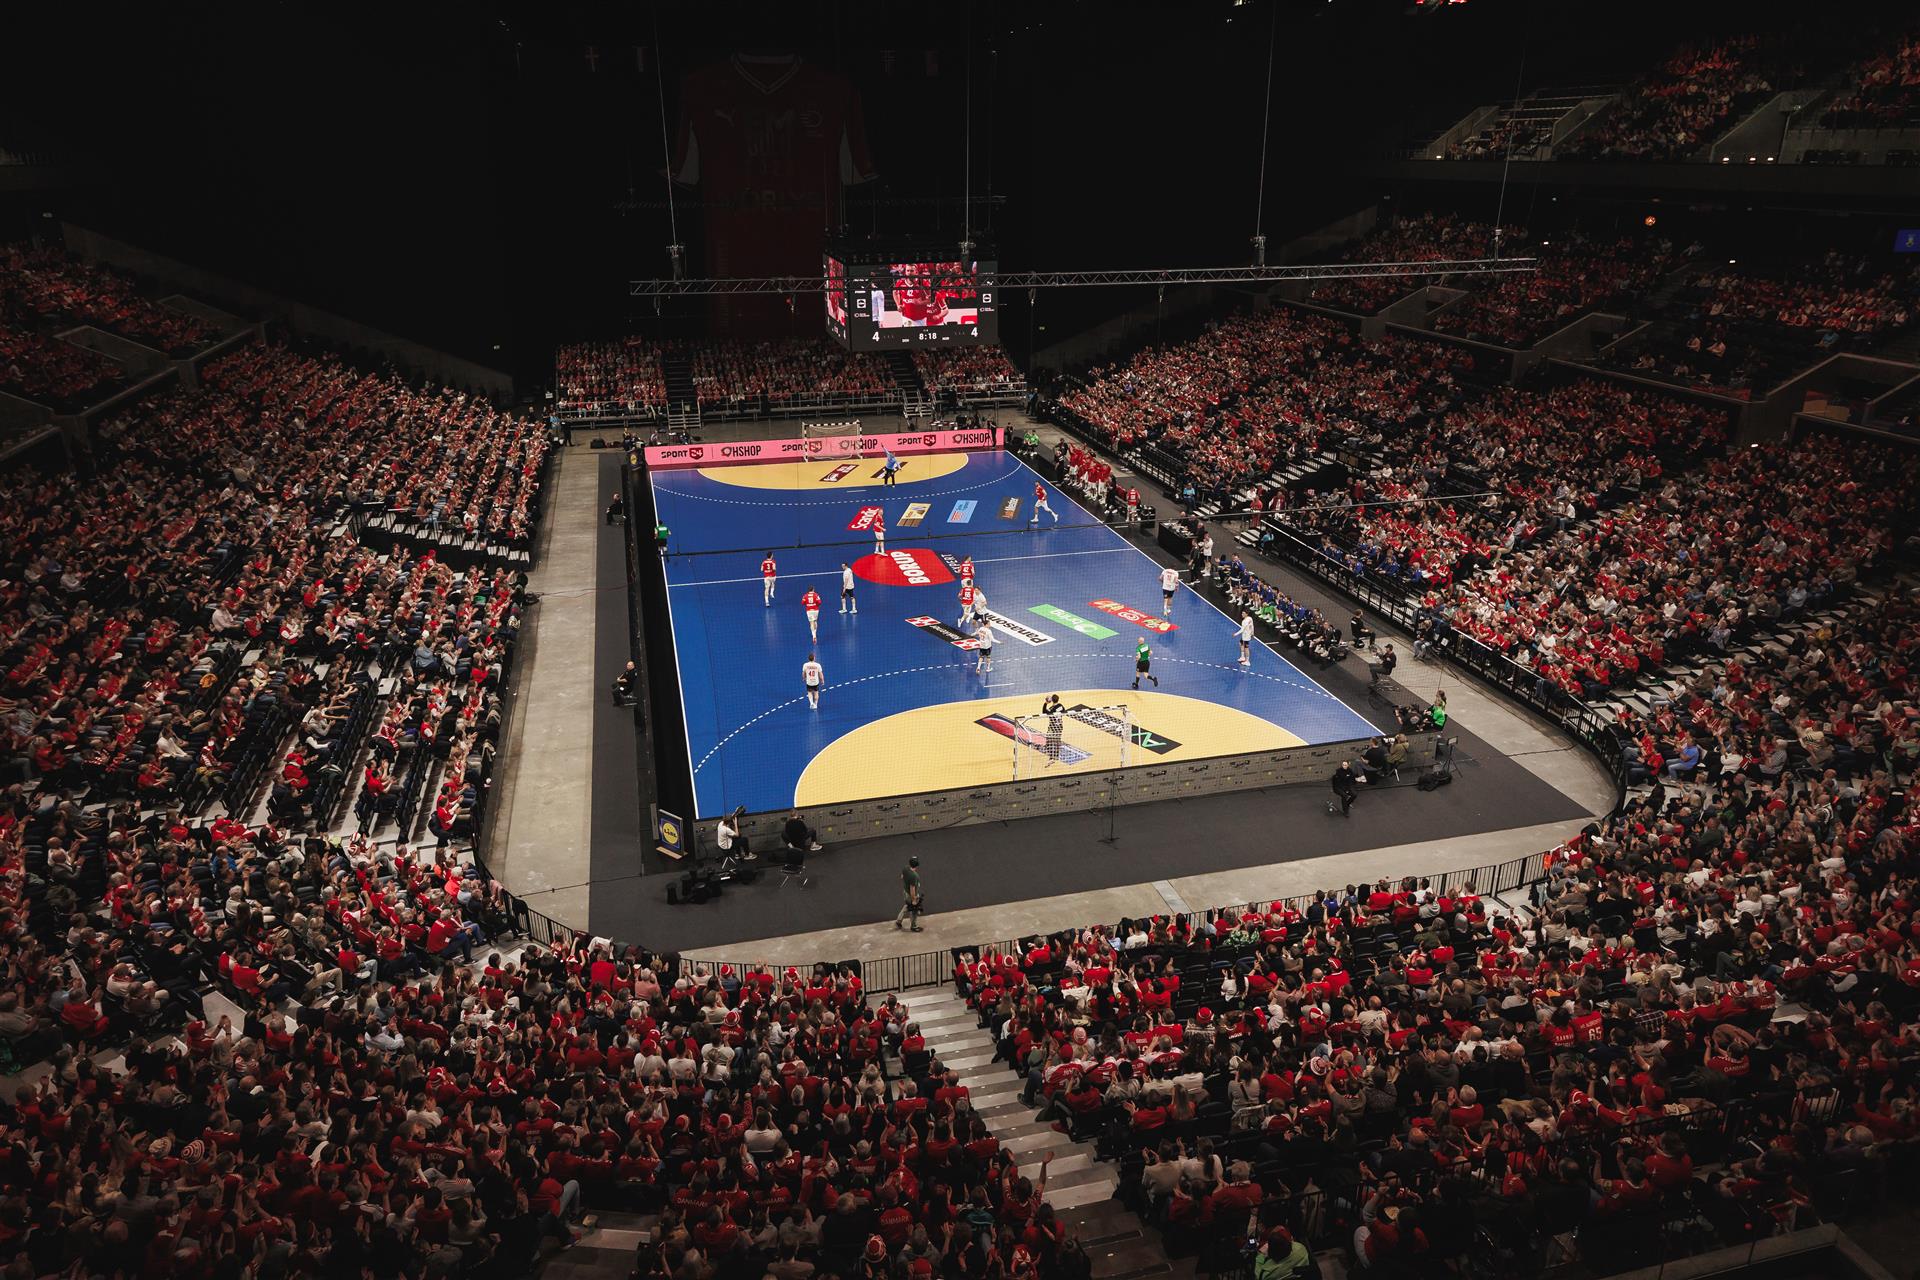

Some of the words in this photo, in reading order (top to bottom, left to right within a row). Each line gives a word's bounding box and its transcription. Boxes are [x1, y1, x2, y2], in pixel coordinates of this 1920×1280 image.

[872, 332, 879, 341] 4
[971, 327, 978, 337] 4
[897, 437, 922, 445] SPORT
[661, 450, 688, 458] SPORT
[890, 551, 931, 584] BORUP
[1589, 1027, 1602, 1040] 65
